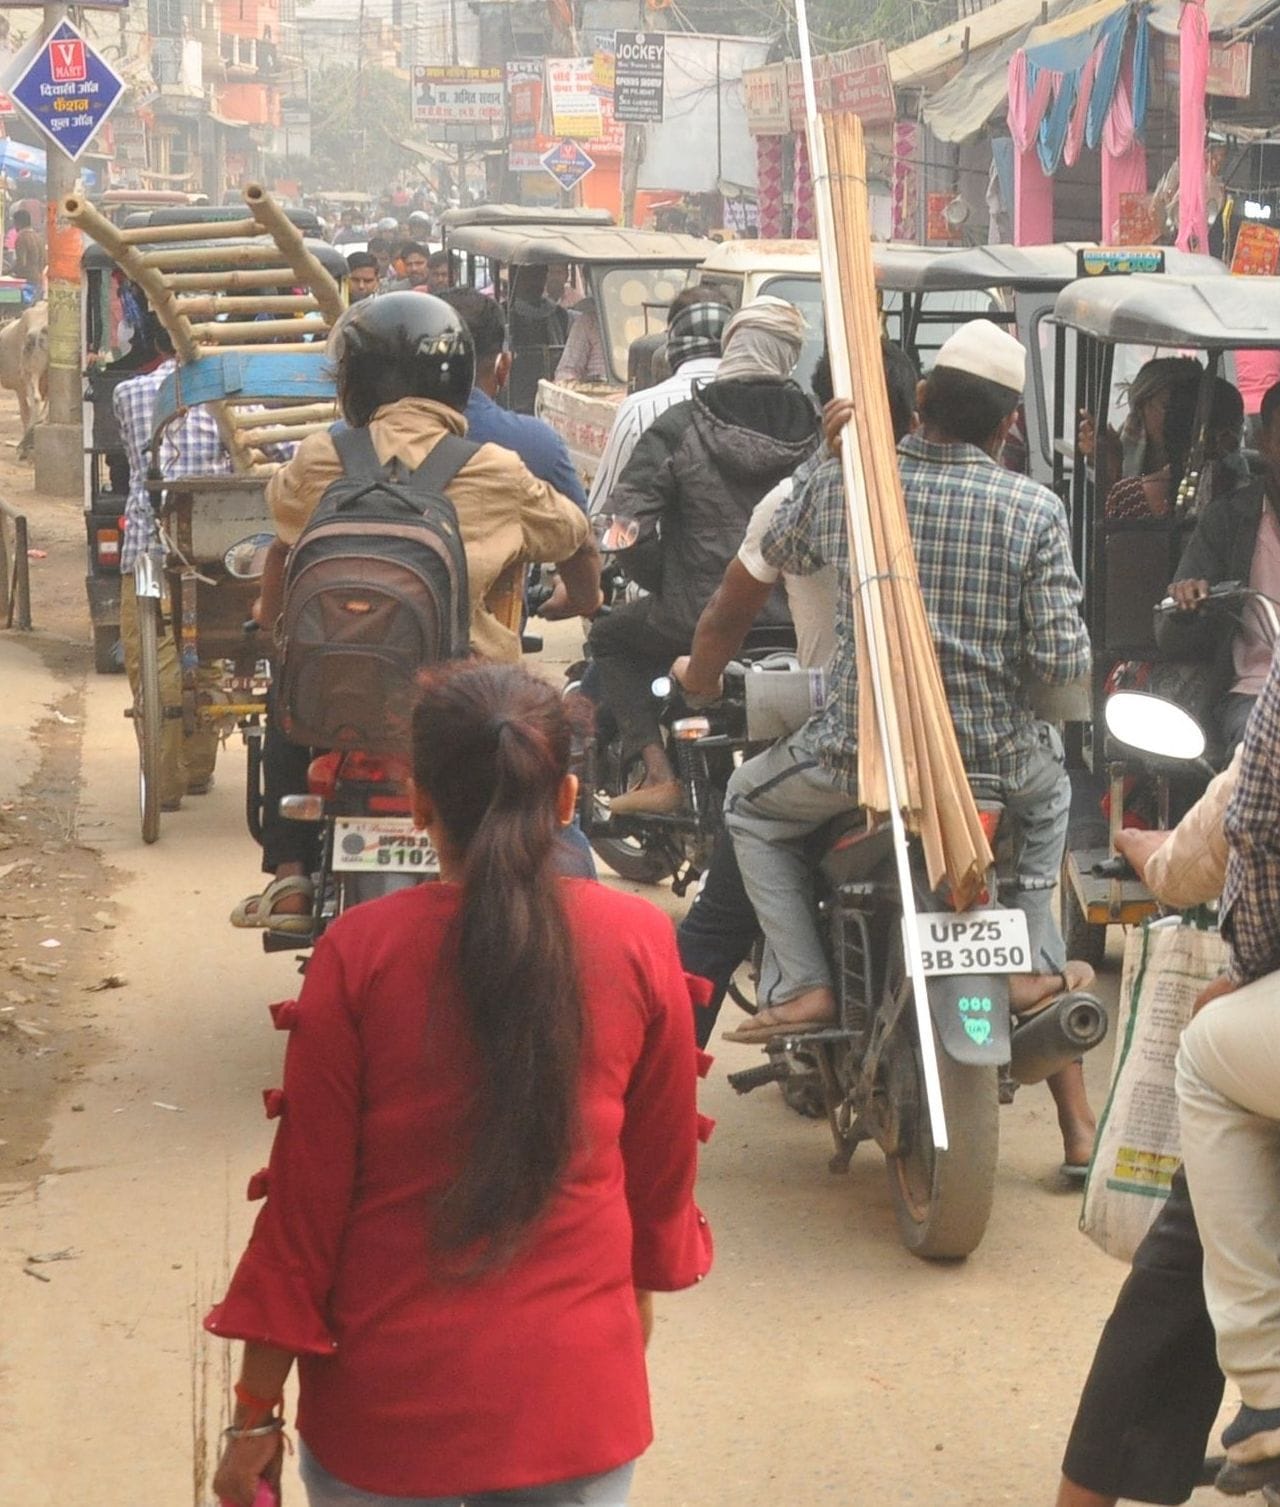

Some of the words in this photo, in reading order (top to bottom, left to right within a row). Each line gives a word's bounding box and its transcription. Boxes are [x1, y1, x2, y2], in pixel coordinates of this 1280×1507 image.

[57, 44, 76, 66] V
[616, 44, 664, 60] JOCKEY
[56, 67, 80, 77] MART
[931, 922, 1002, 943] UP25
[959, 946, 1024, 968] 3050
